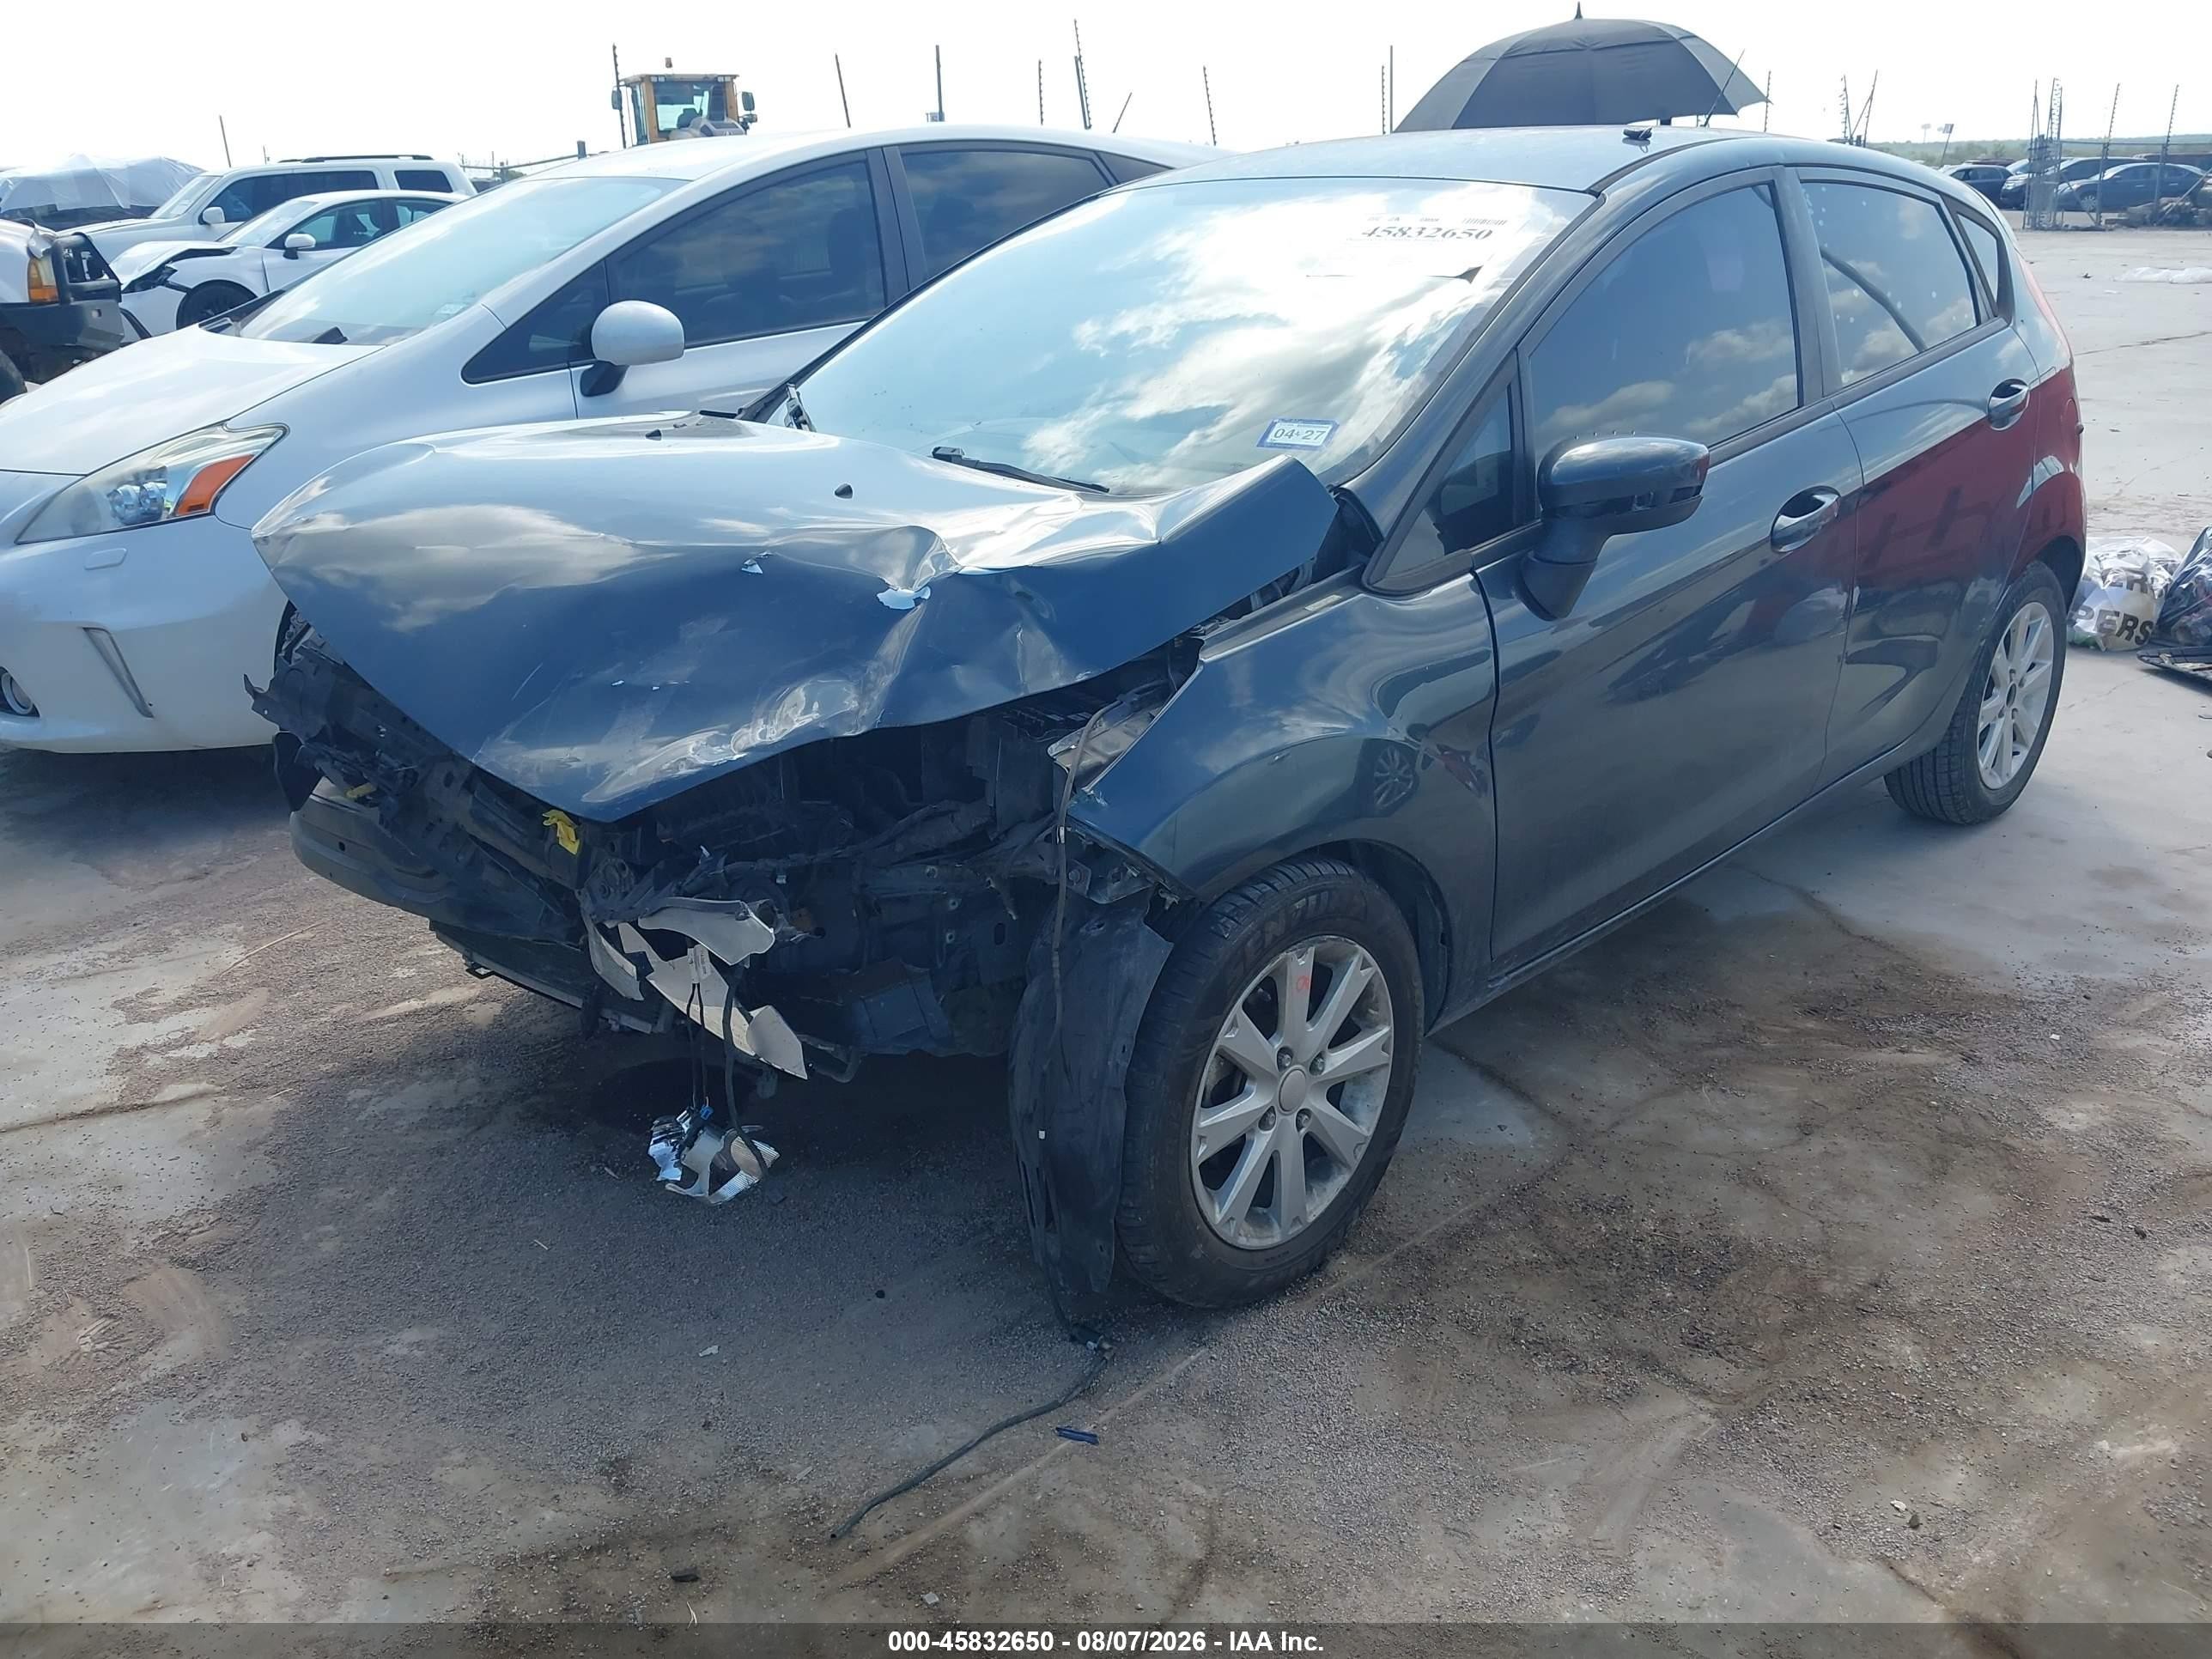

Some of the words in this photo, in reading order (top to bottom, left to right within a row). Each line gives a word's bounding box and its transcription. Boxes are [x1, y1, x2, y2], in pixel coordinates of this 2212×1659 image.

[1362, 226, 1492, 240] 45832650
[1273, 428, 1296, 440] 04
[1302, 430, 1327, 441] 27
